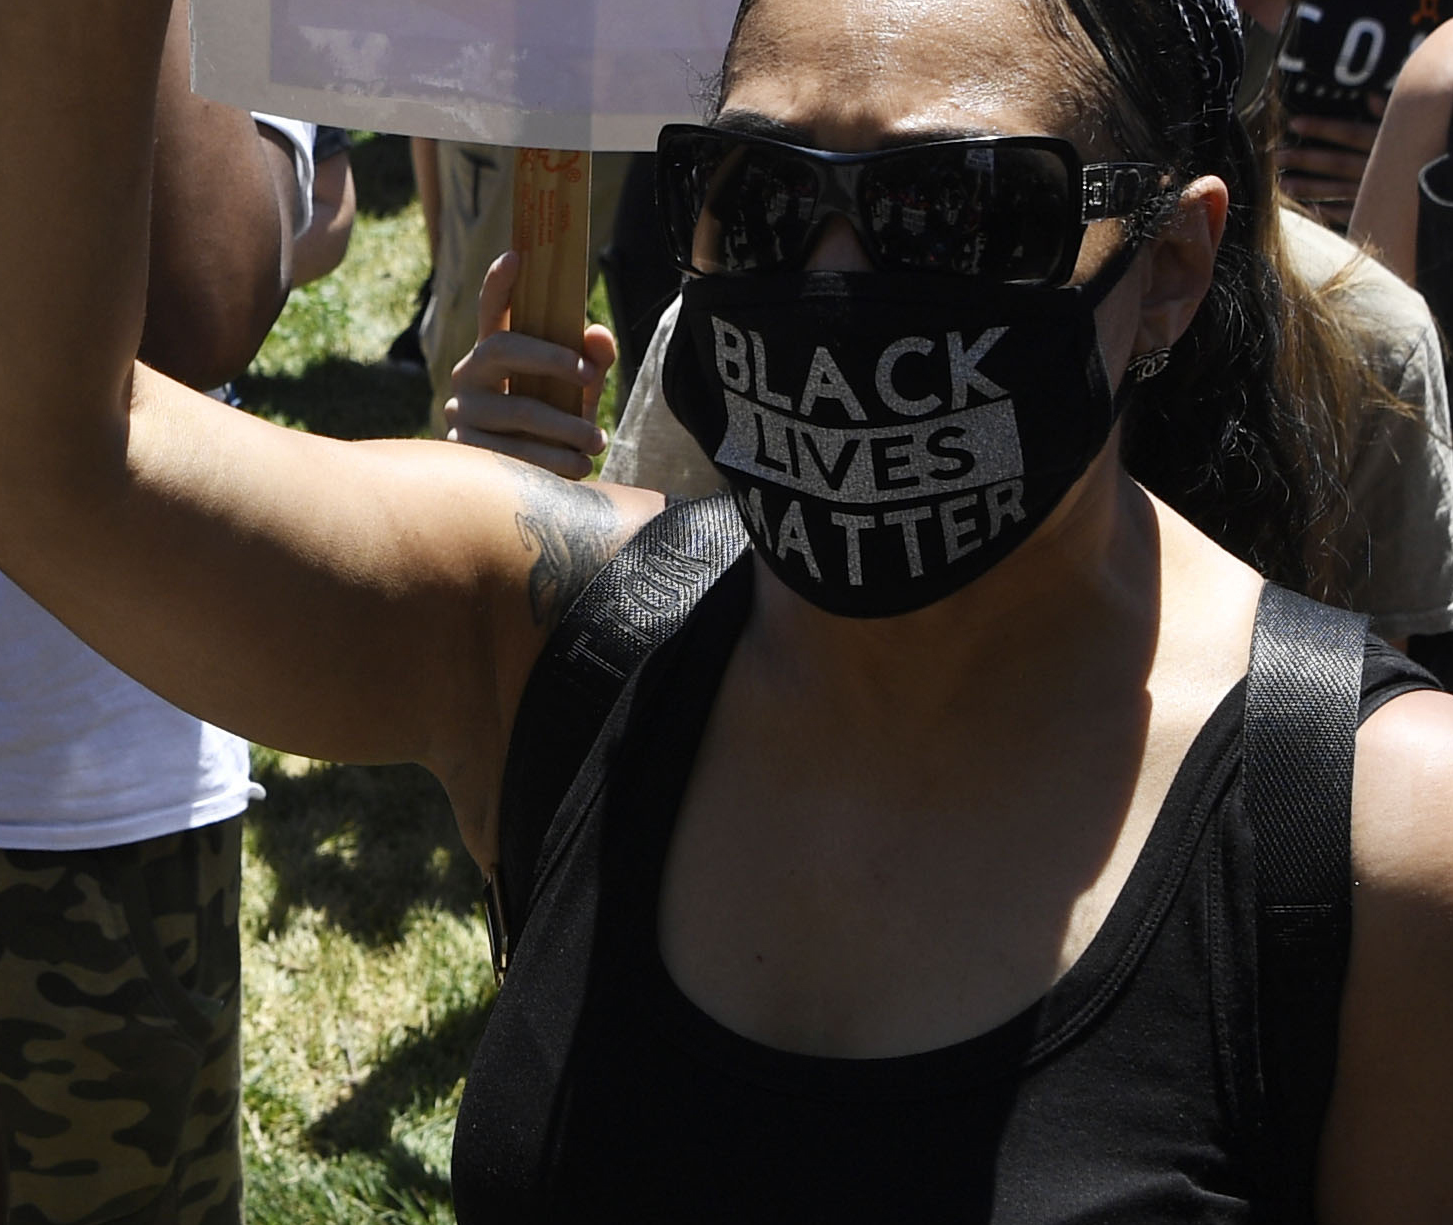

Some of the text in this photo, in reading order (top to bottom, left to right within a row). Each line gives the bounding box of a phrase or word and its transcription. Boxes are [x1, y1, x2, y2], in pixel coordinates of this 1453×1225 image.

[711, 315, 1013, 422] BLACK
[754, 412, 976, 492] LIVES
[745, 479, 1028, 587] MATTER
